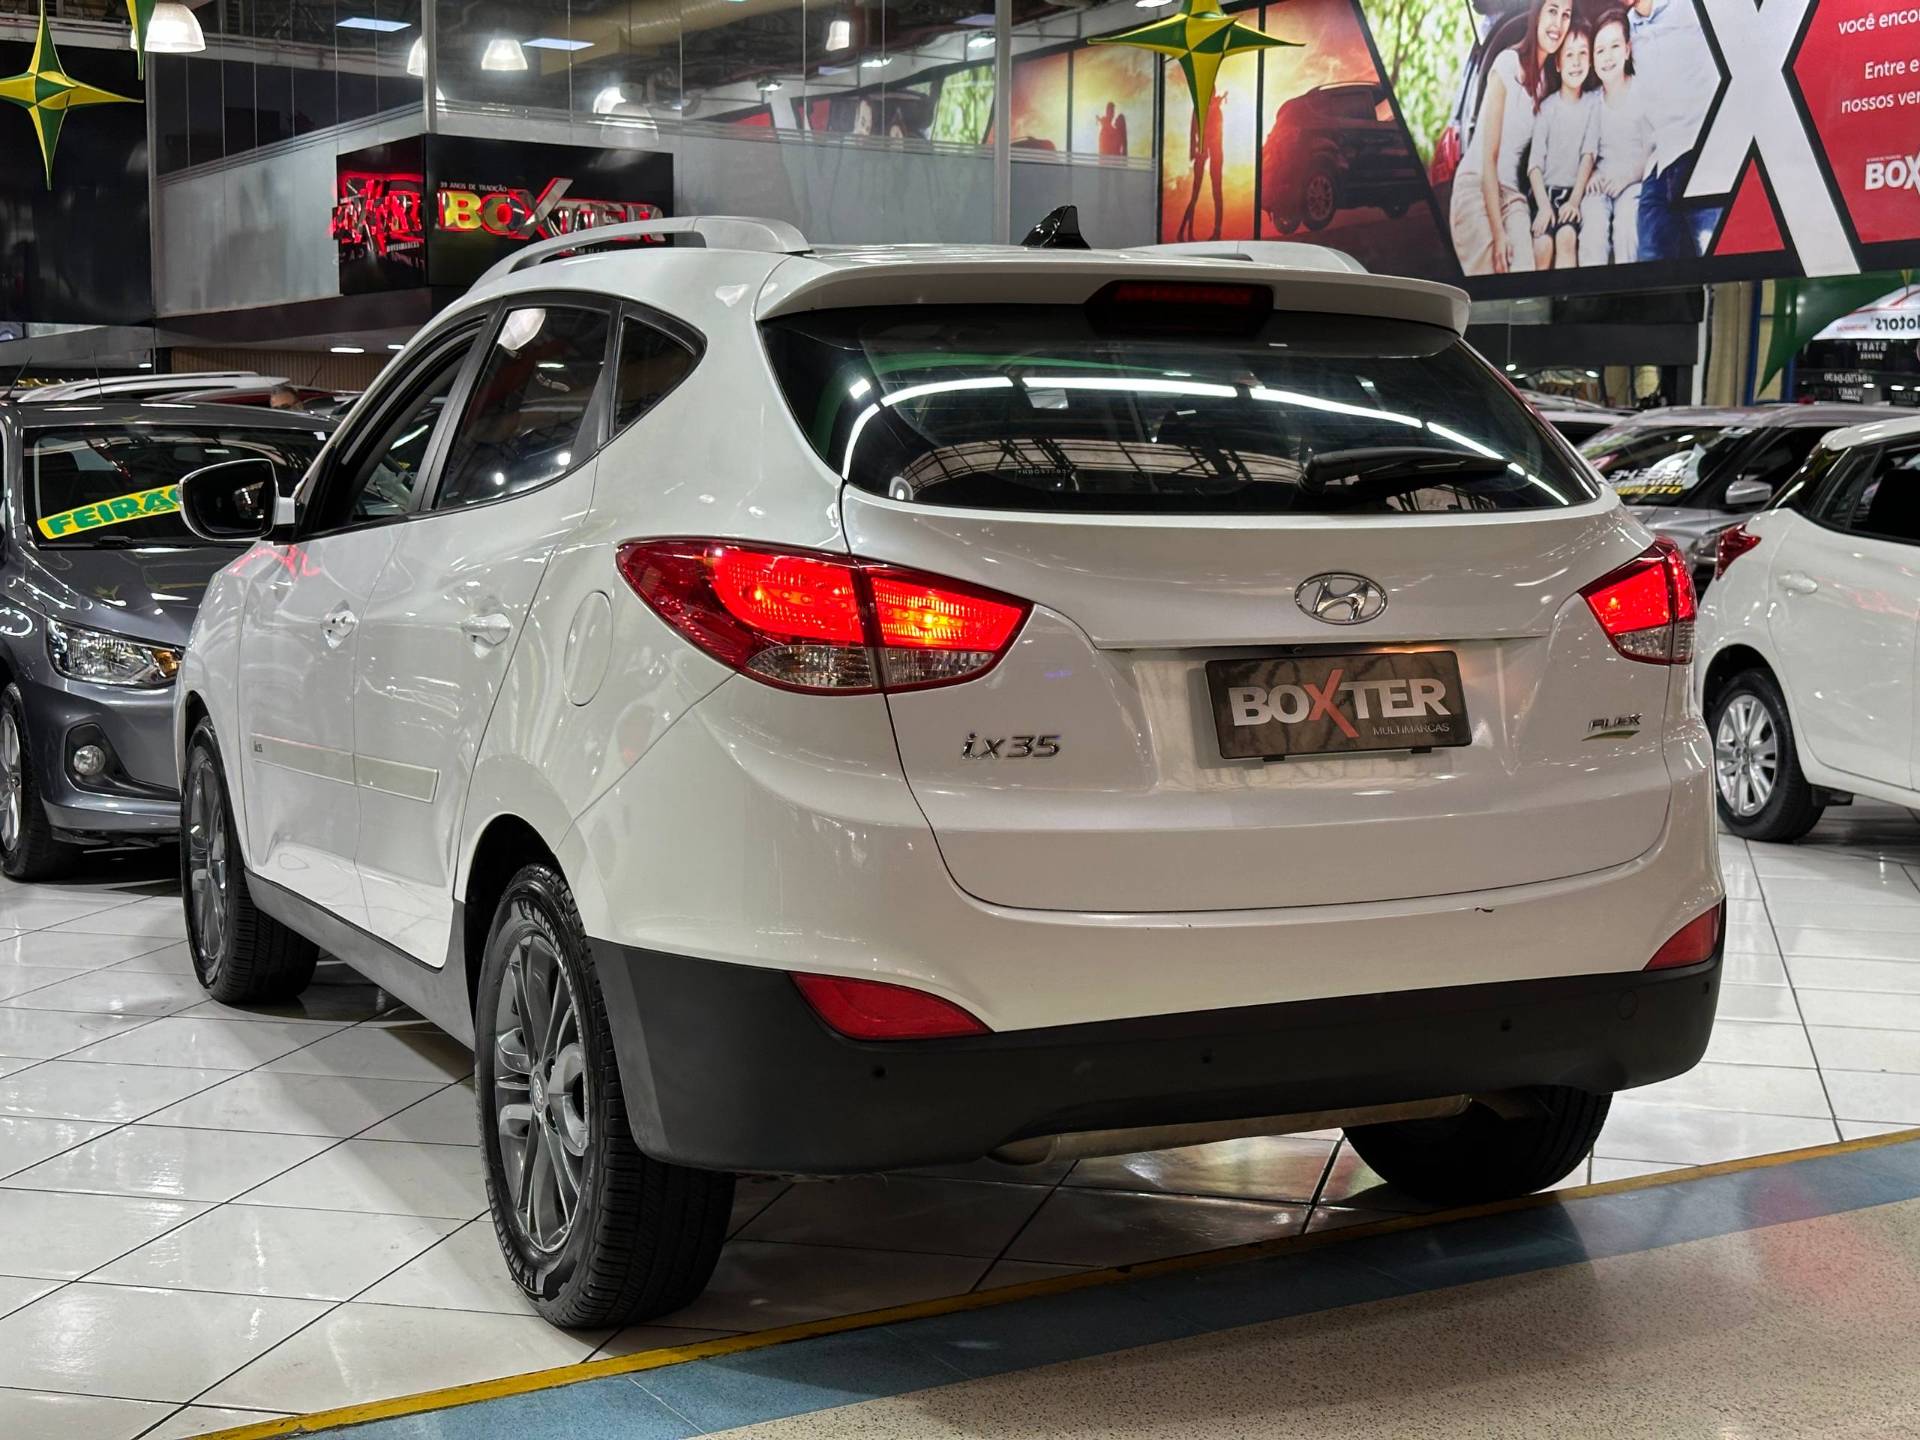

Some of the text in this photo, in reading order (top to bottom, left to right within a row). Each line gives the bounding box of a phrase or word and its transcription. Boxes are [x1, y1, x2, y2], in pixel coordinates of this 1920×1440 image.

[1838, 8, 1920, 35] você enco
[1865, 60, 1905, 79] Entre
[1841, 93, 1894, 114] nossos
[436, 176, 666, 243] BOXTER
[1228, 669, 1452, 738] BOXTER
[1372, 723, 1450, 736] MULTIMARCAS
[961, 732, 1062, 759] ix35
